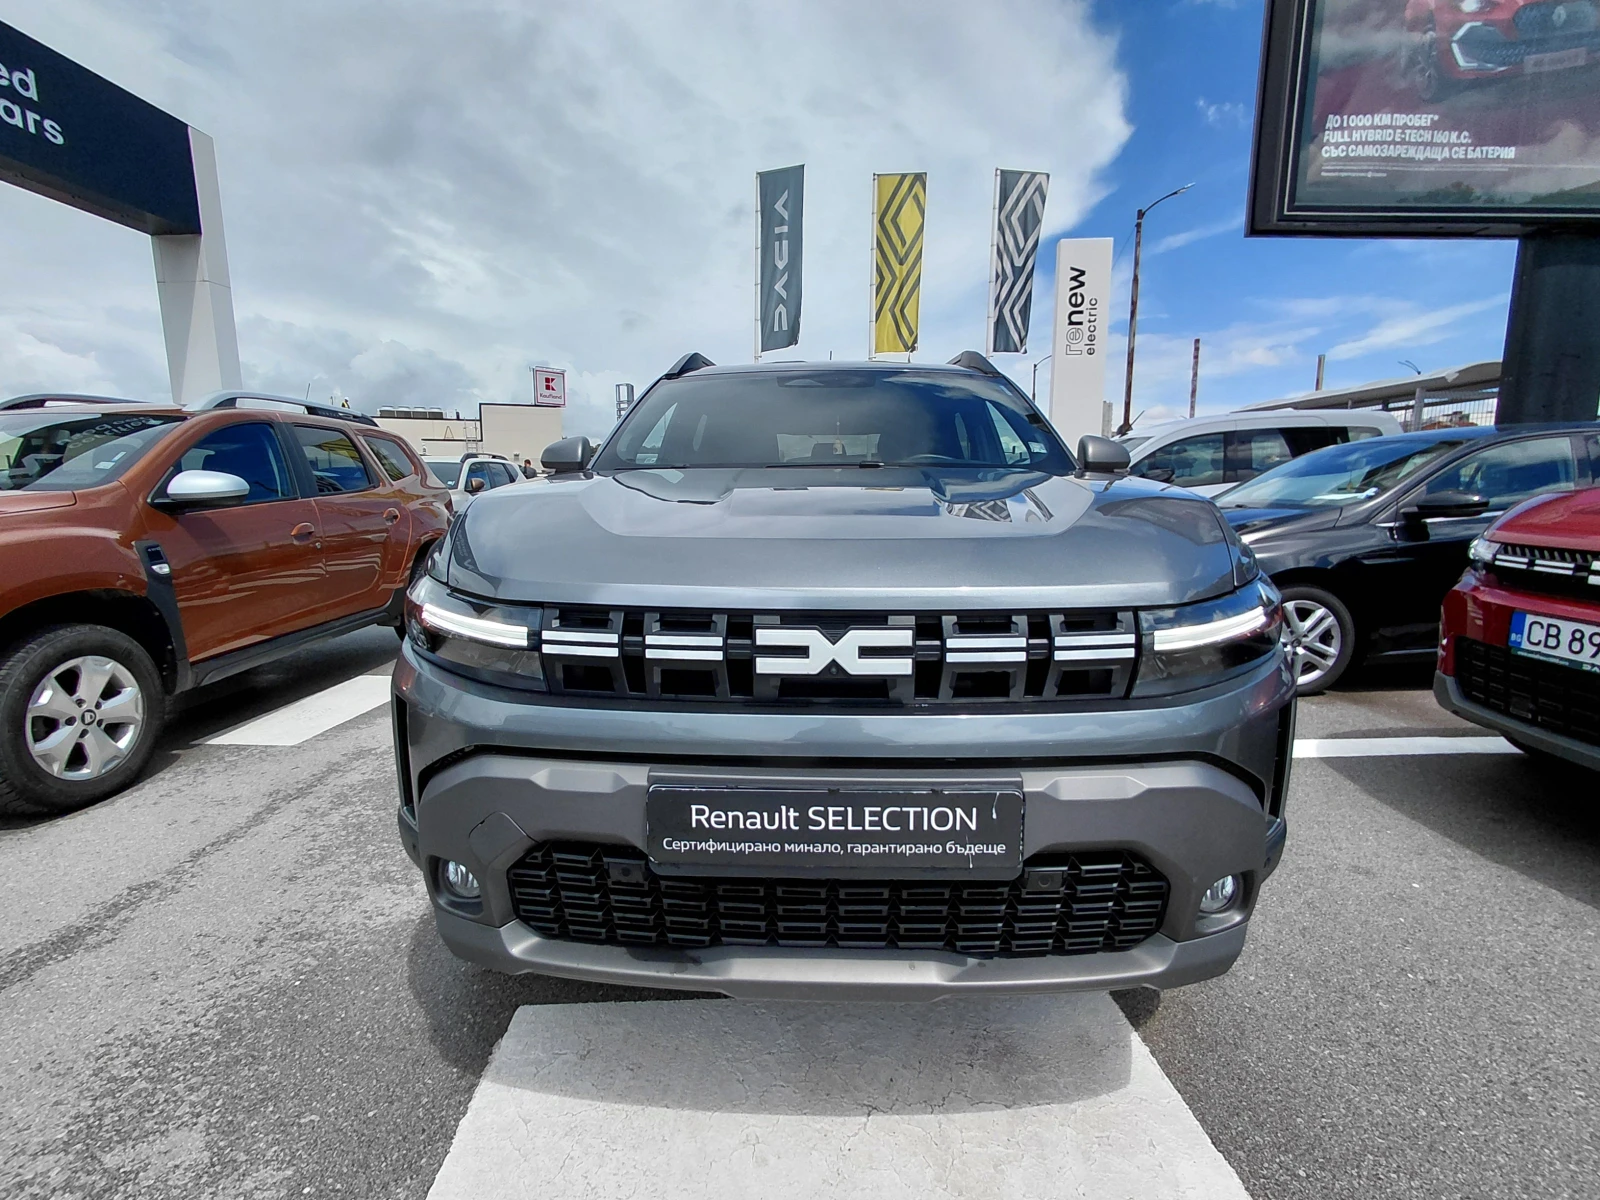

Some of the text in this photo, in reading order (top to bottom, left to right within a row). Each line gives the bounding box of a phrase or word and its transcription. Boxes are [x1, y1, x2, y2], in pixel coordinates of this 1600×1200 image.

[1325, 114, 1341, 130] ДО
[1373, 113, 1391, 126] КМ
[1323, 130, 1351, 143] FULL
[1352, 129, 1394, 142] HYBRID
[1395, 129, 1432, 143] E-TECH
[1321, 145, 1516, 161] СЪС САМОЗАРЕЖДАЩА СЕ БАТЕРИЯ
[774, 188, 789, 332] DACIA
[1084, 297, 1098, 356] electric
[1511, 633, 1521, 642] BG
[690, 805, 977, 831] Renault SELECTION
[662, 837, 1007, 857] Сертифицирано минало, гарантирано бъдеще
